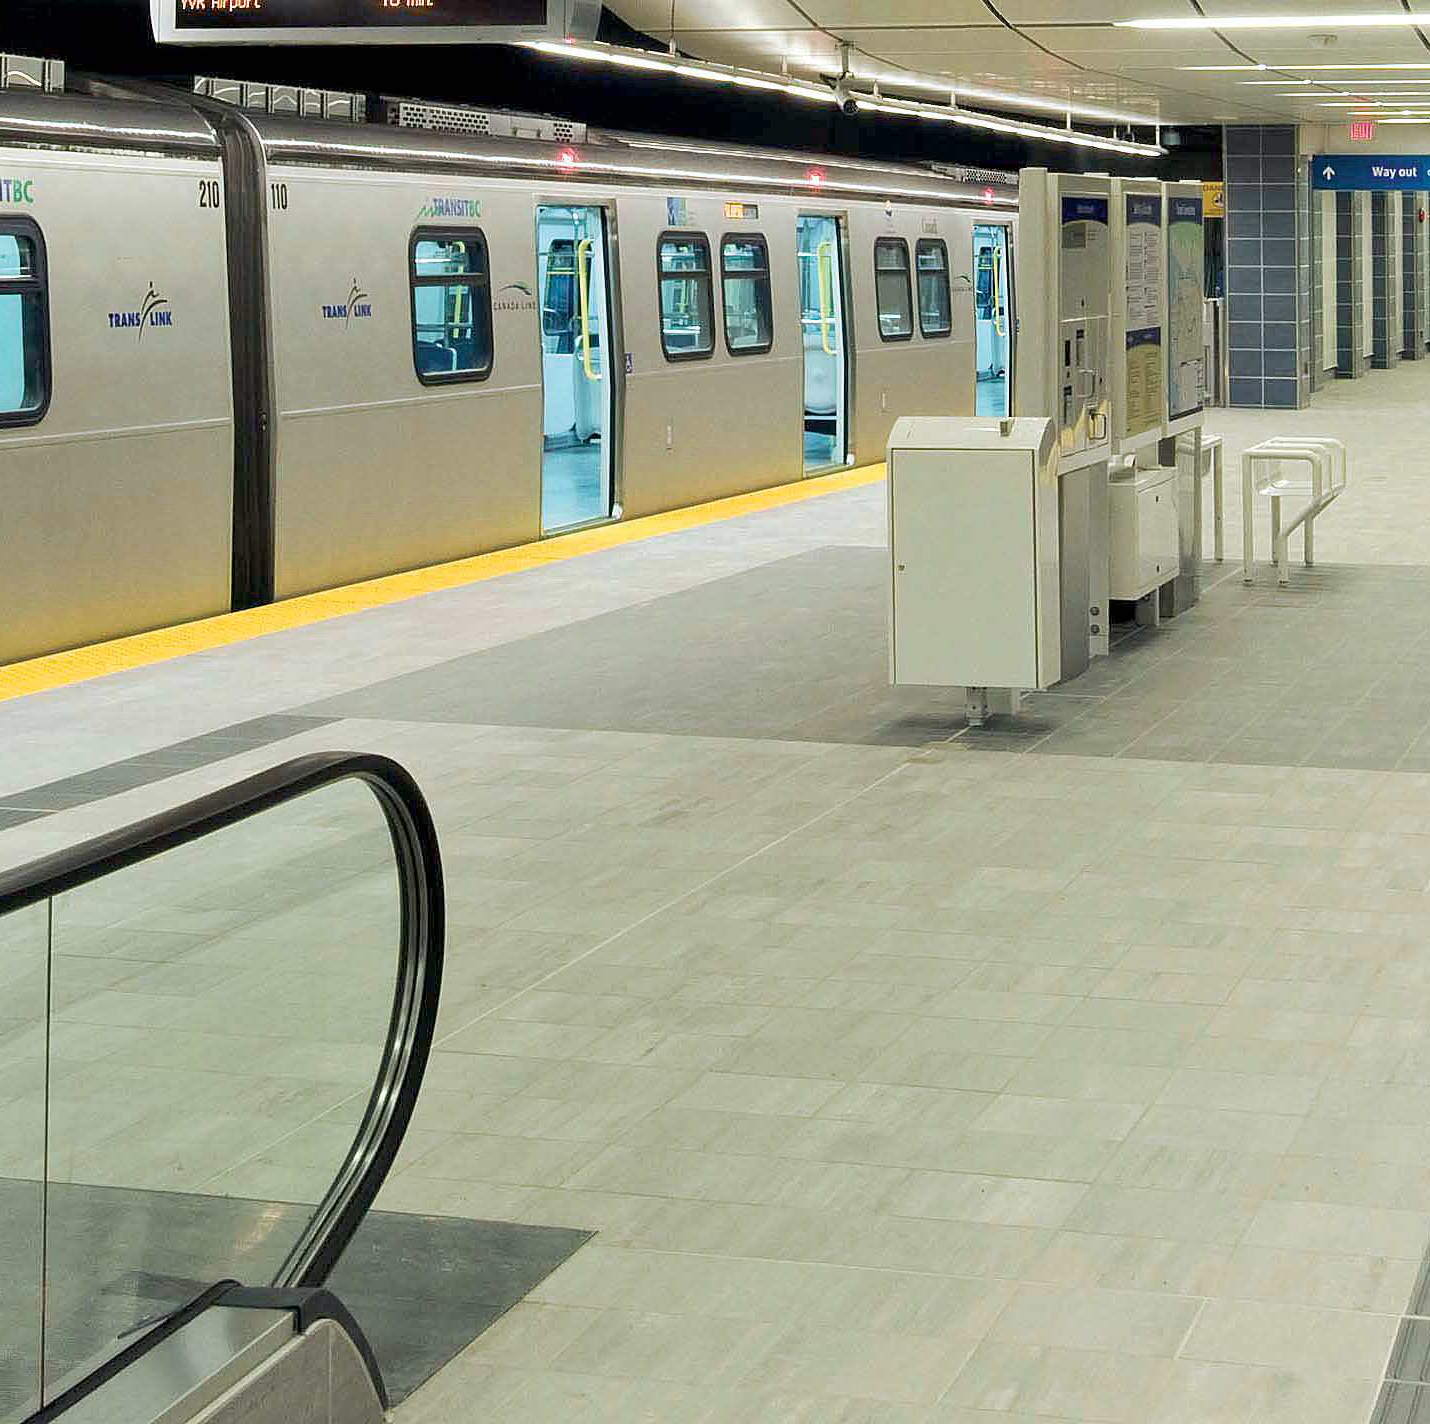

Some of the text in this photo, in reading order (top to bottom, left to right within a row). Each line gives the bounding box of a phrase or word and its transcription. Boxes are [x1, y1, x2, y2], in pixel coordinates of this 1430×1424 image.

[1371, 166, 1418, 179] Way out
[199, 180, 220, 208] 210
[270, 183, 287, 210] 110
